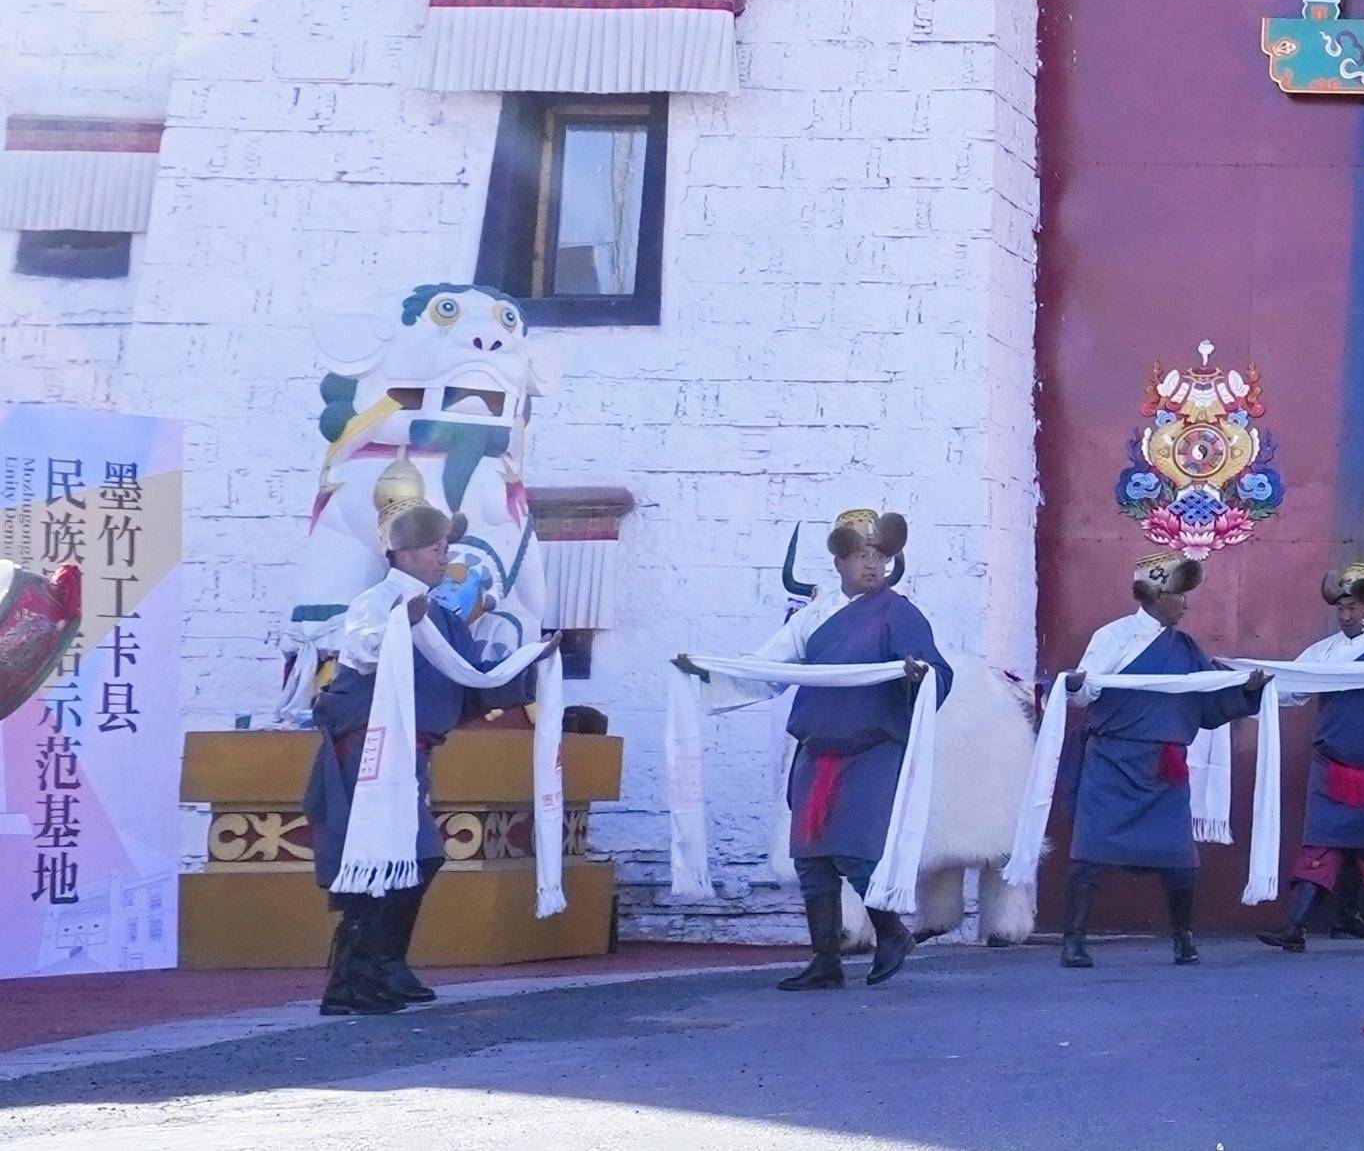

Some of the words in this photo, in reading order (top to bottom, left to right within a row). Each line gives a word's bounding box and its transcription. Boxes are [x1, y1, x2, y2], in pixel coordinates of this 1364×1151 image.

[20, 458, 36, 571] Mozhugongk
[96, 461, 143, 734] 墨竹工卡县
[31, 457, 88, 906] 民族示范基地
